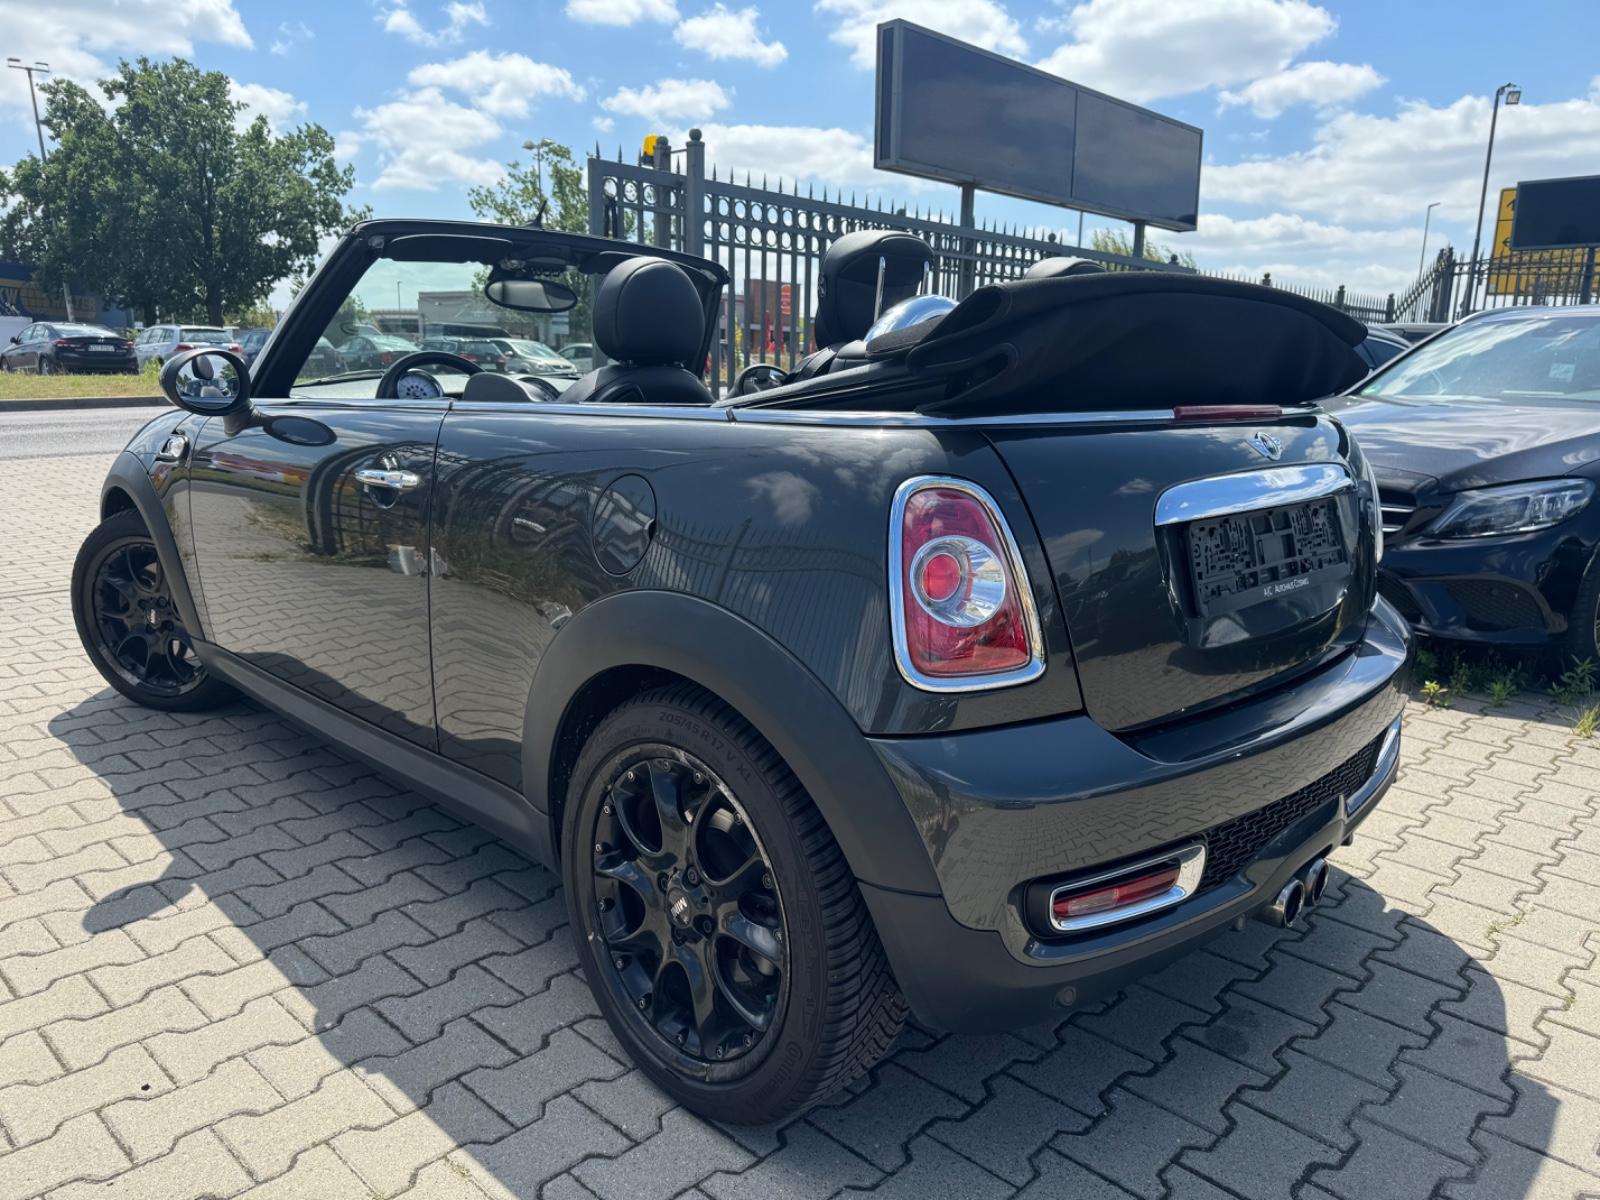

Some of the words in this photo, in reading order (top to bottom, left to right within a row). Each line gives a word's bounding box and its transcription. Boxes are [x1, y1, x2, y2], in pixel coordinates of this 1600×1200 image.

[659, 711, 700, 734] 205/45
[700, 730, 711, 742] R
[711, 740, 725, 752] 17
